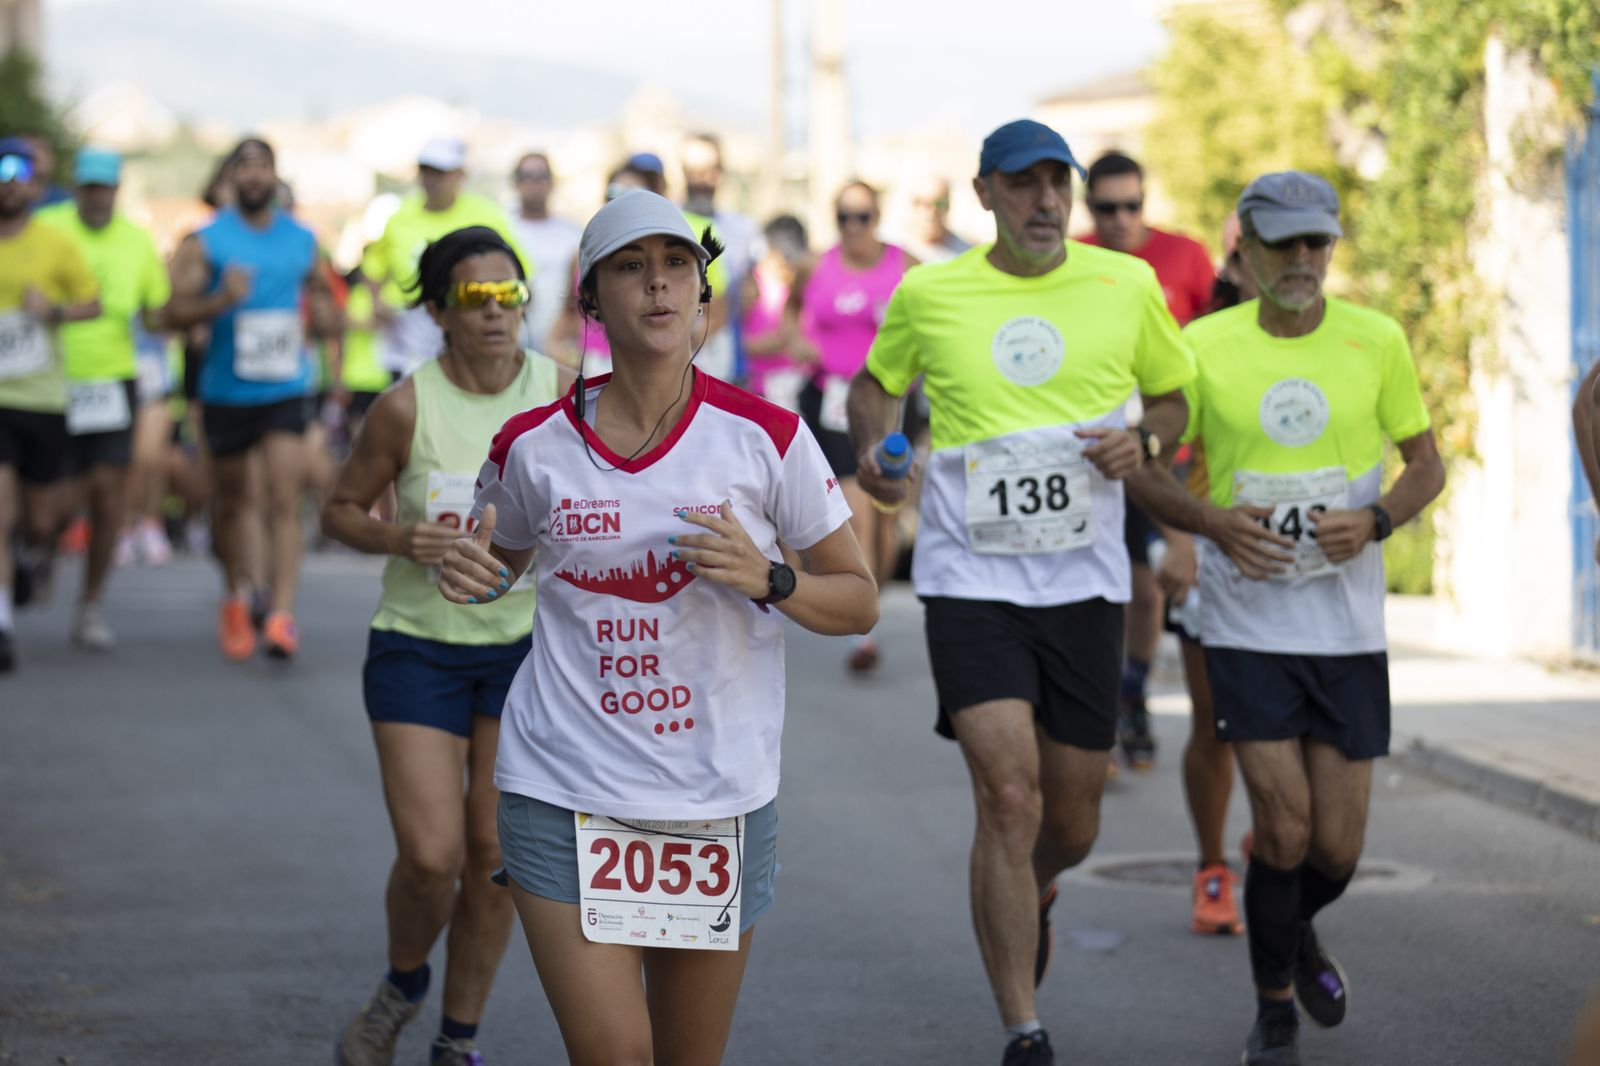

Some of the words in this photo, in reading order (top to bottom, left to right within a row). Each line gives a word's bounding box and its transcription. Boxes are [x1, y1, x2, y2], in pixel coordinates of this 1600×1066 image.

[573, 499, 620, 510] eDreams
[989, 473, 1070, 516] 138
[566, 511, 621, 535] BCN
[597, 618, 659, 643] RUN
[600, 654, 660, 678] FOR
[600, 685, 691, 715] GOOD
[590, 837, 731, 897] 2053
